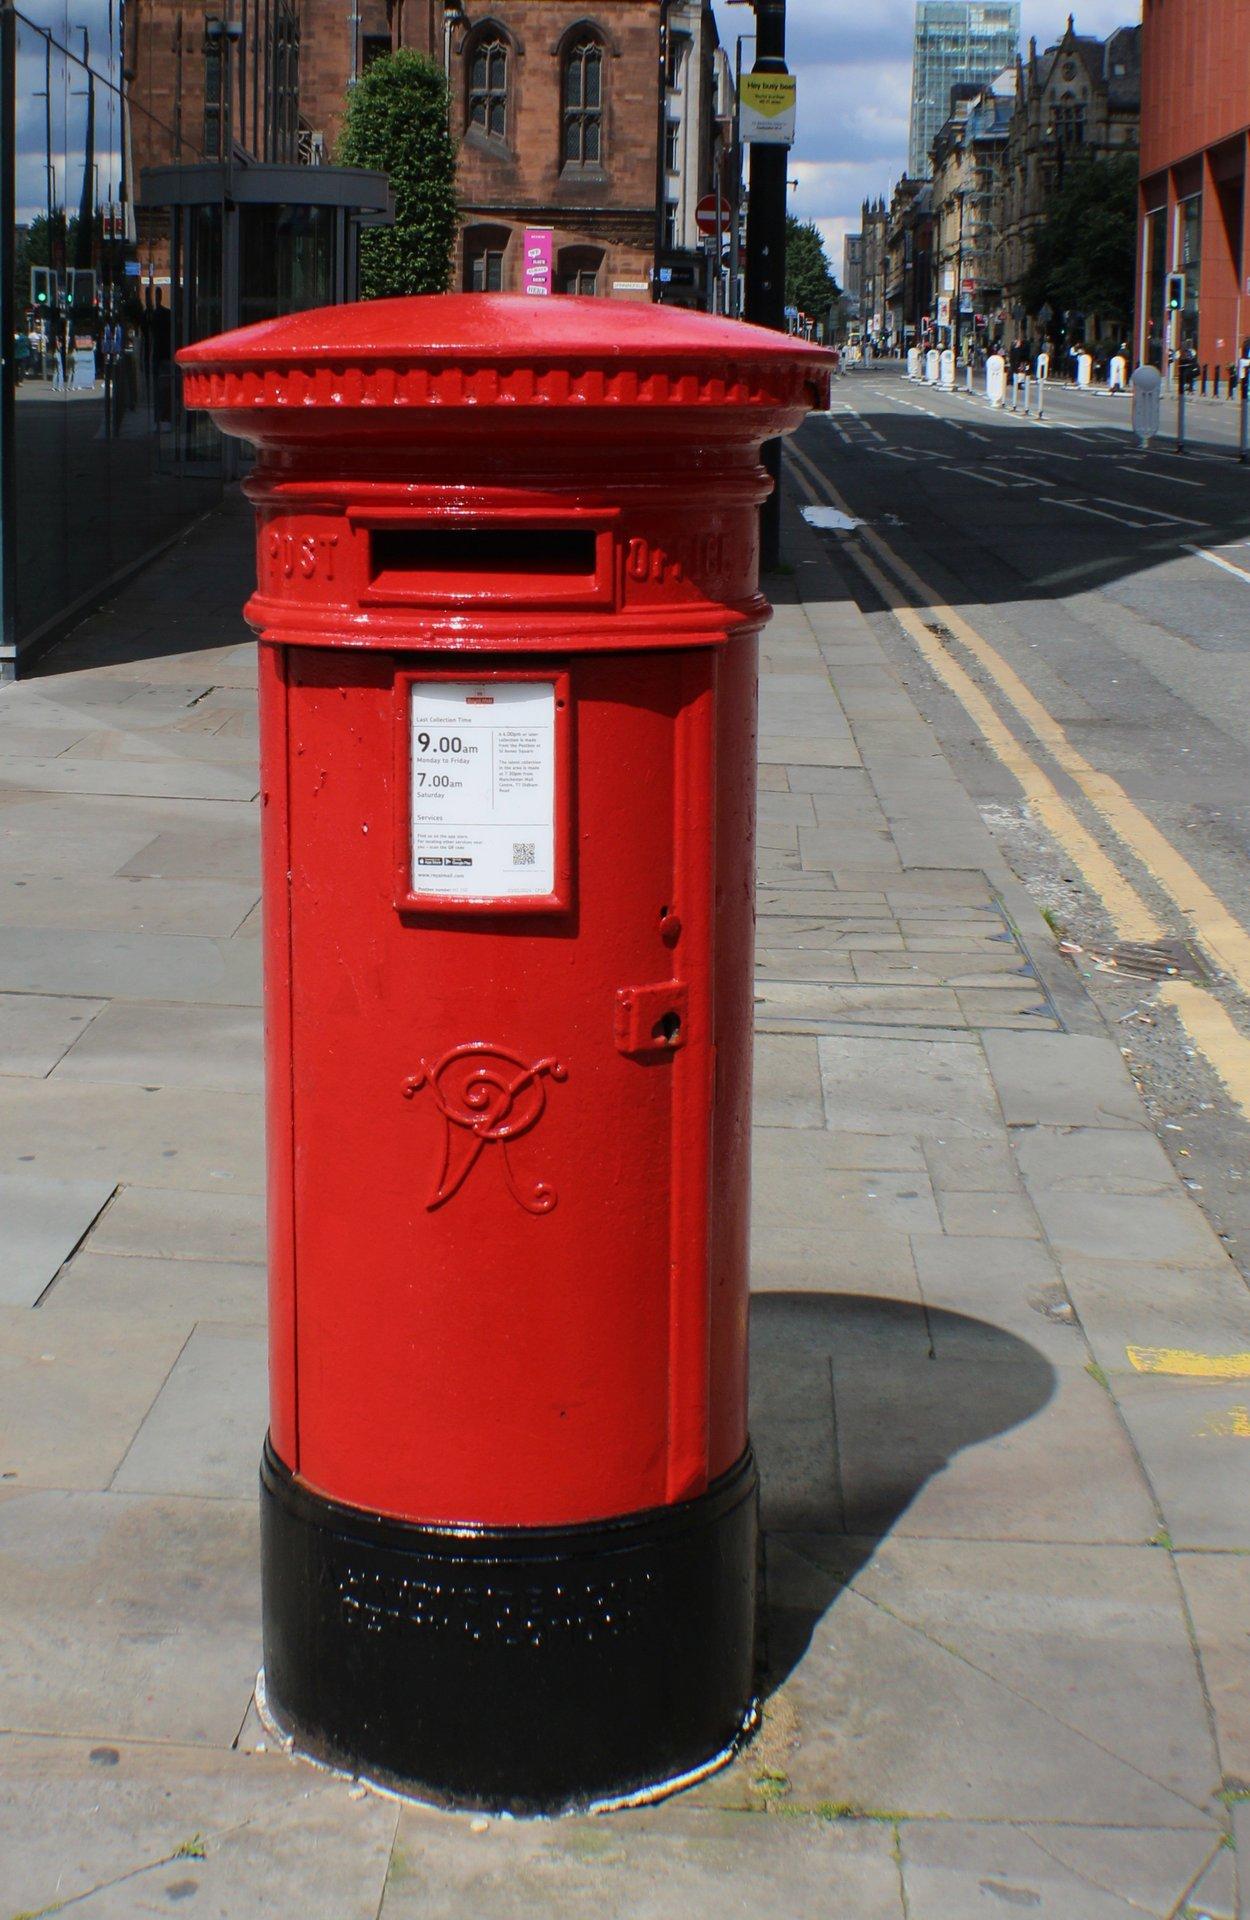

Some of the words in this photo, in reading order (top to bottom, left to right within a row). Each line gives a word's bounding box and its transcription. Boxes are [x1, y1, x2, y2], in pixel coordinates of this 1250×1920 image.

[268, 531, 339, 582] POST
[417, 732, 478, 754] 9.00am
[417, 757, 441, 765] Monday
[451, 757, 470, 765] Friday
[417, 772, 463, 788] 7.00am
[417, 791, 445, 799] Saturday
